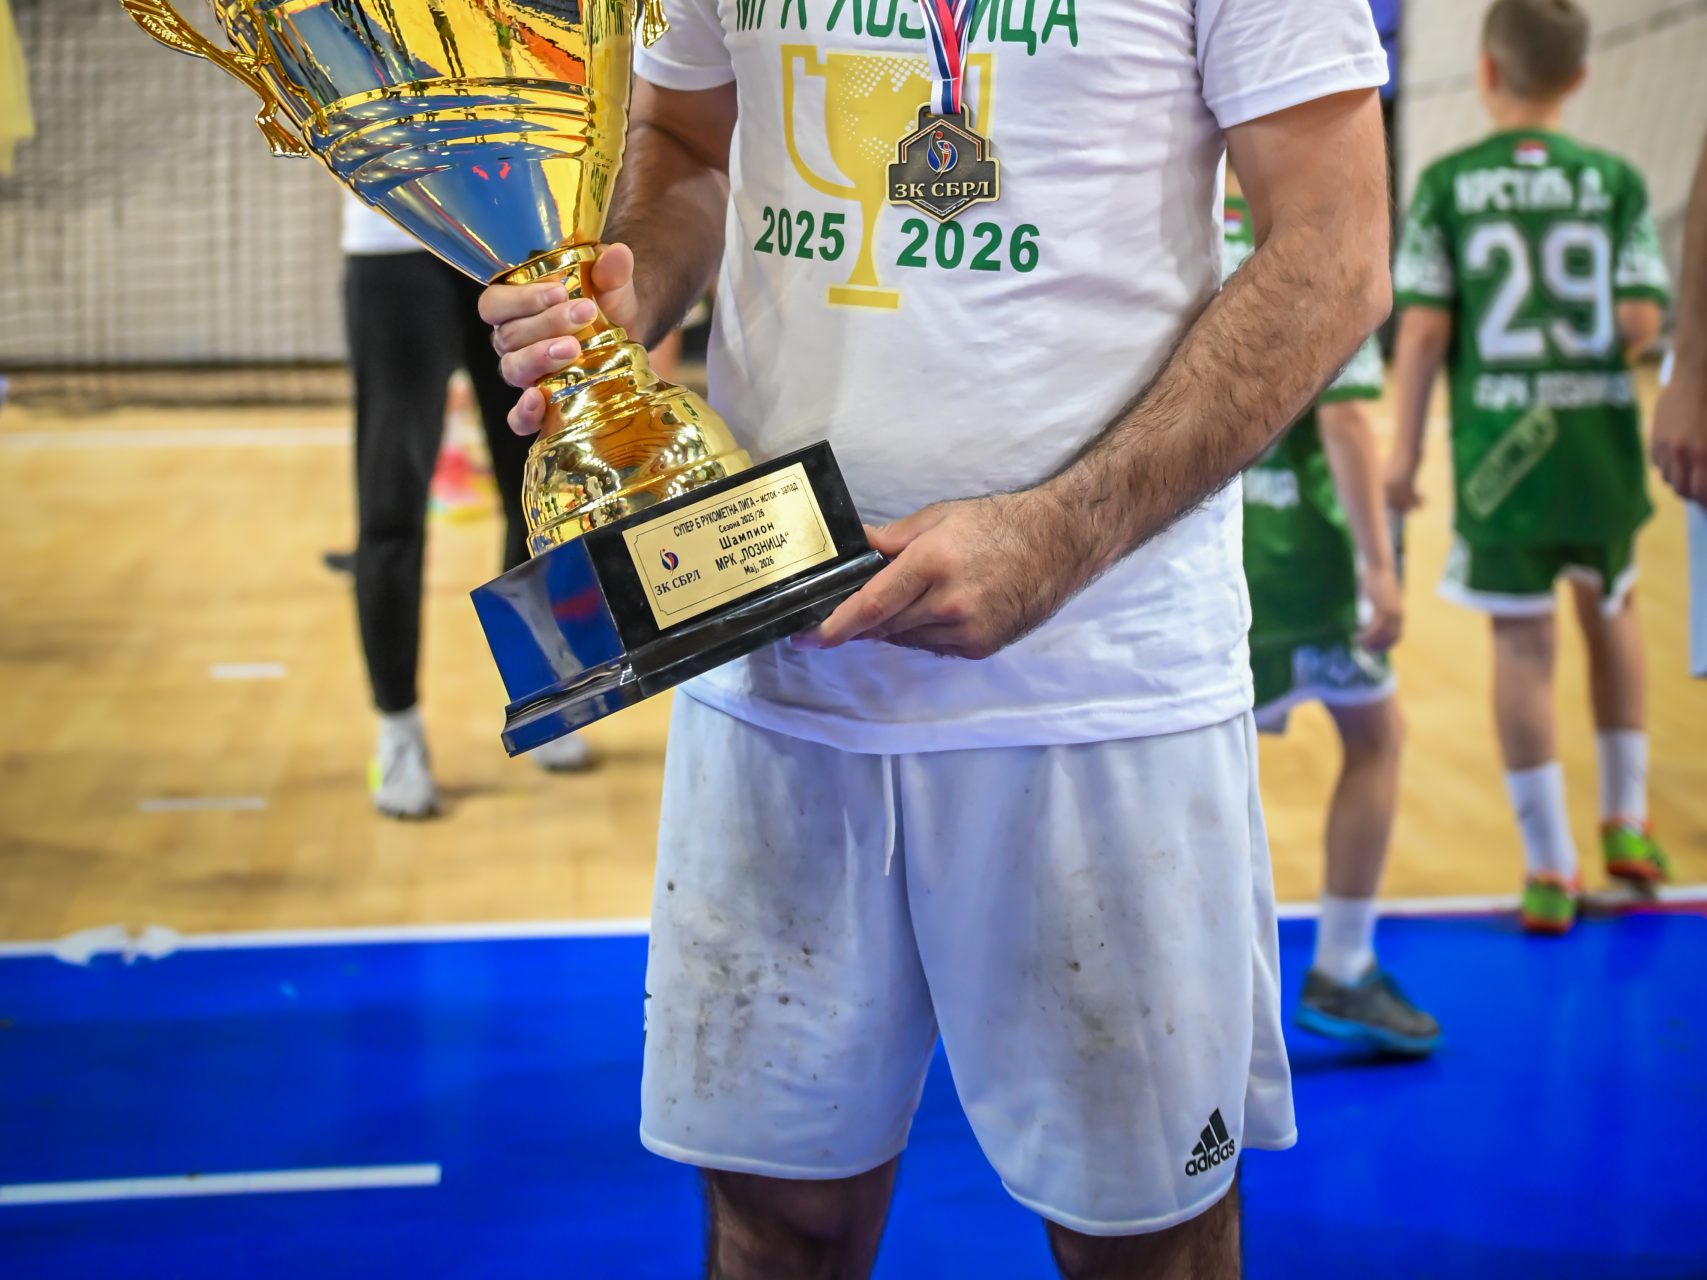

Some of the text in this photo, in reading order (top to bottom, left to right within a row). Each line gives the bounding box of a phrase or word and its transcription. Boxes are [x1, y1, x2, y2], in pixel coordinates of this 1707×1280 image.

[894, 180, 992, 199] ЗК СБРЛ
[754, 206, 846, 262] 2025
[896, 219, 1041, 273] 2026
[1466, 221, 1616, 361] 29
[673, 521, 695, 537] СУПЕР
[700, 504, 739, 527] РУКОМЕТНА
[739, 497, 756, 512] ЛИГА
[718, 520, 741, 533] Сезона
[719, 522, 775, 550] Шампион
[715, 553, 737, 572] МРК
[654, 569, 701, 596] ЗК СБРЛ
[1185, 1139, 1235, 1176] adidas
